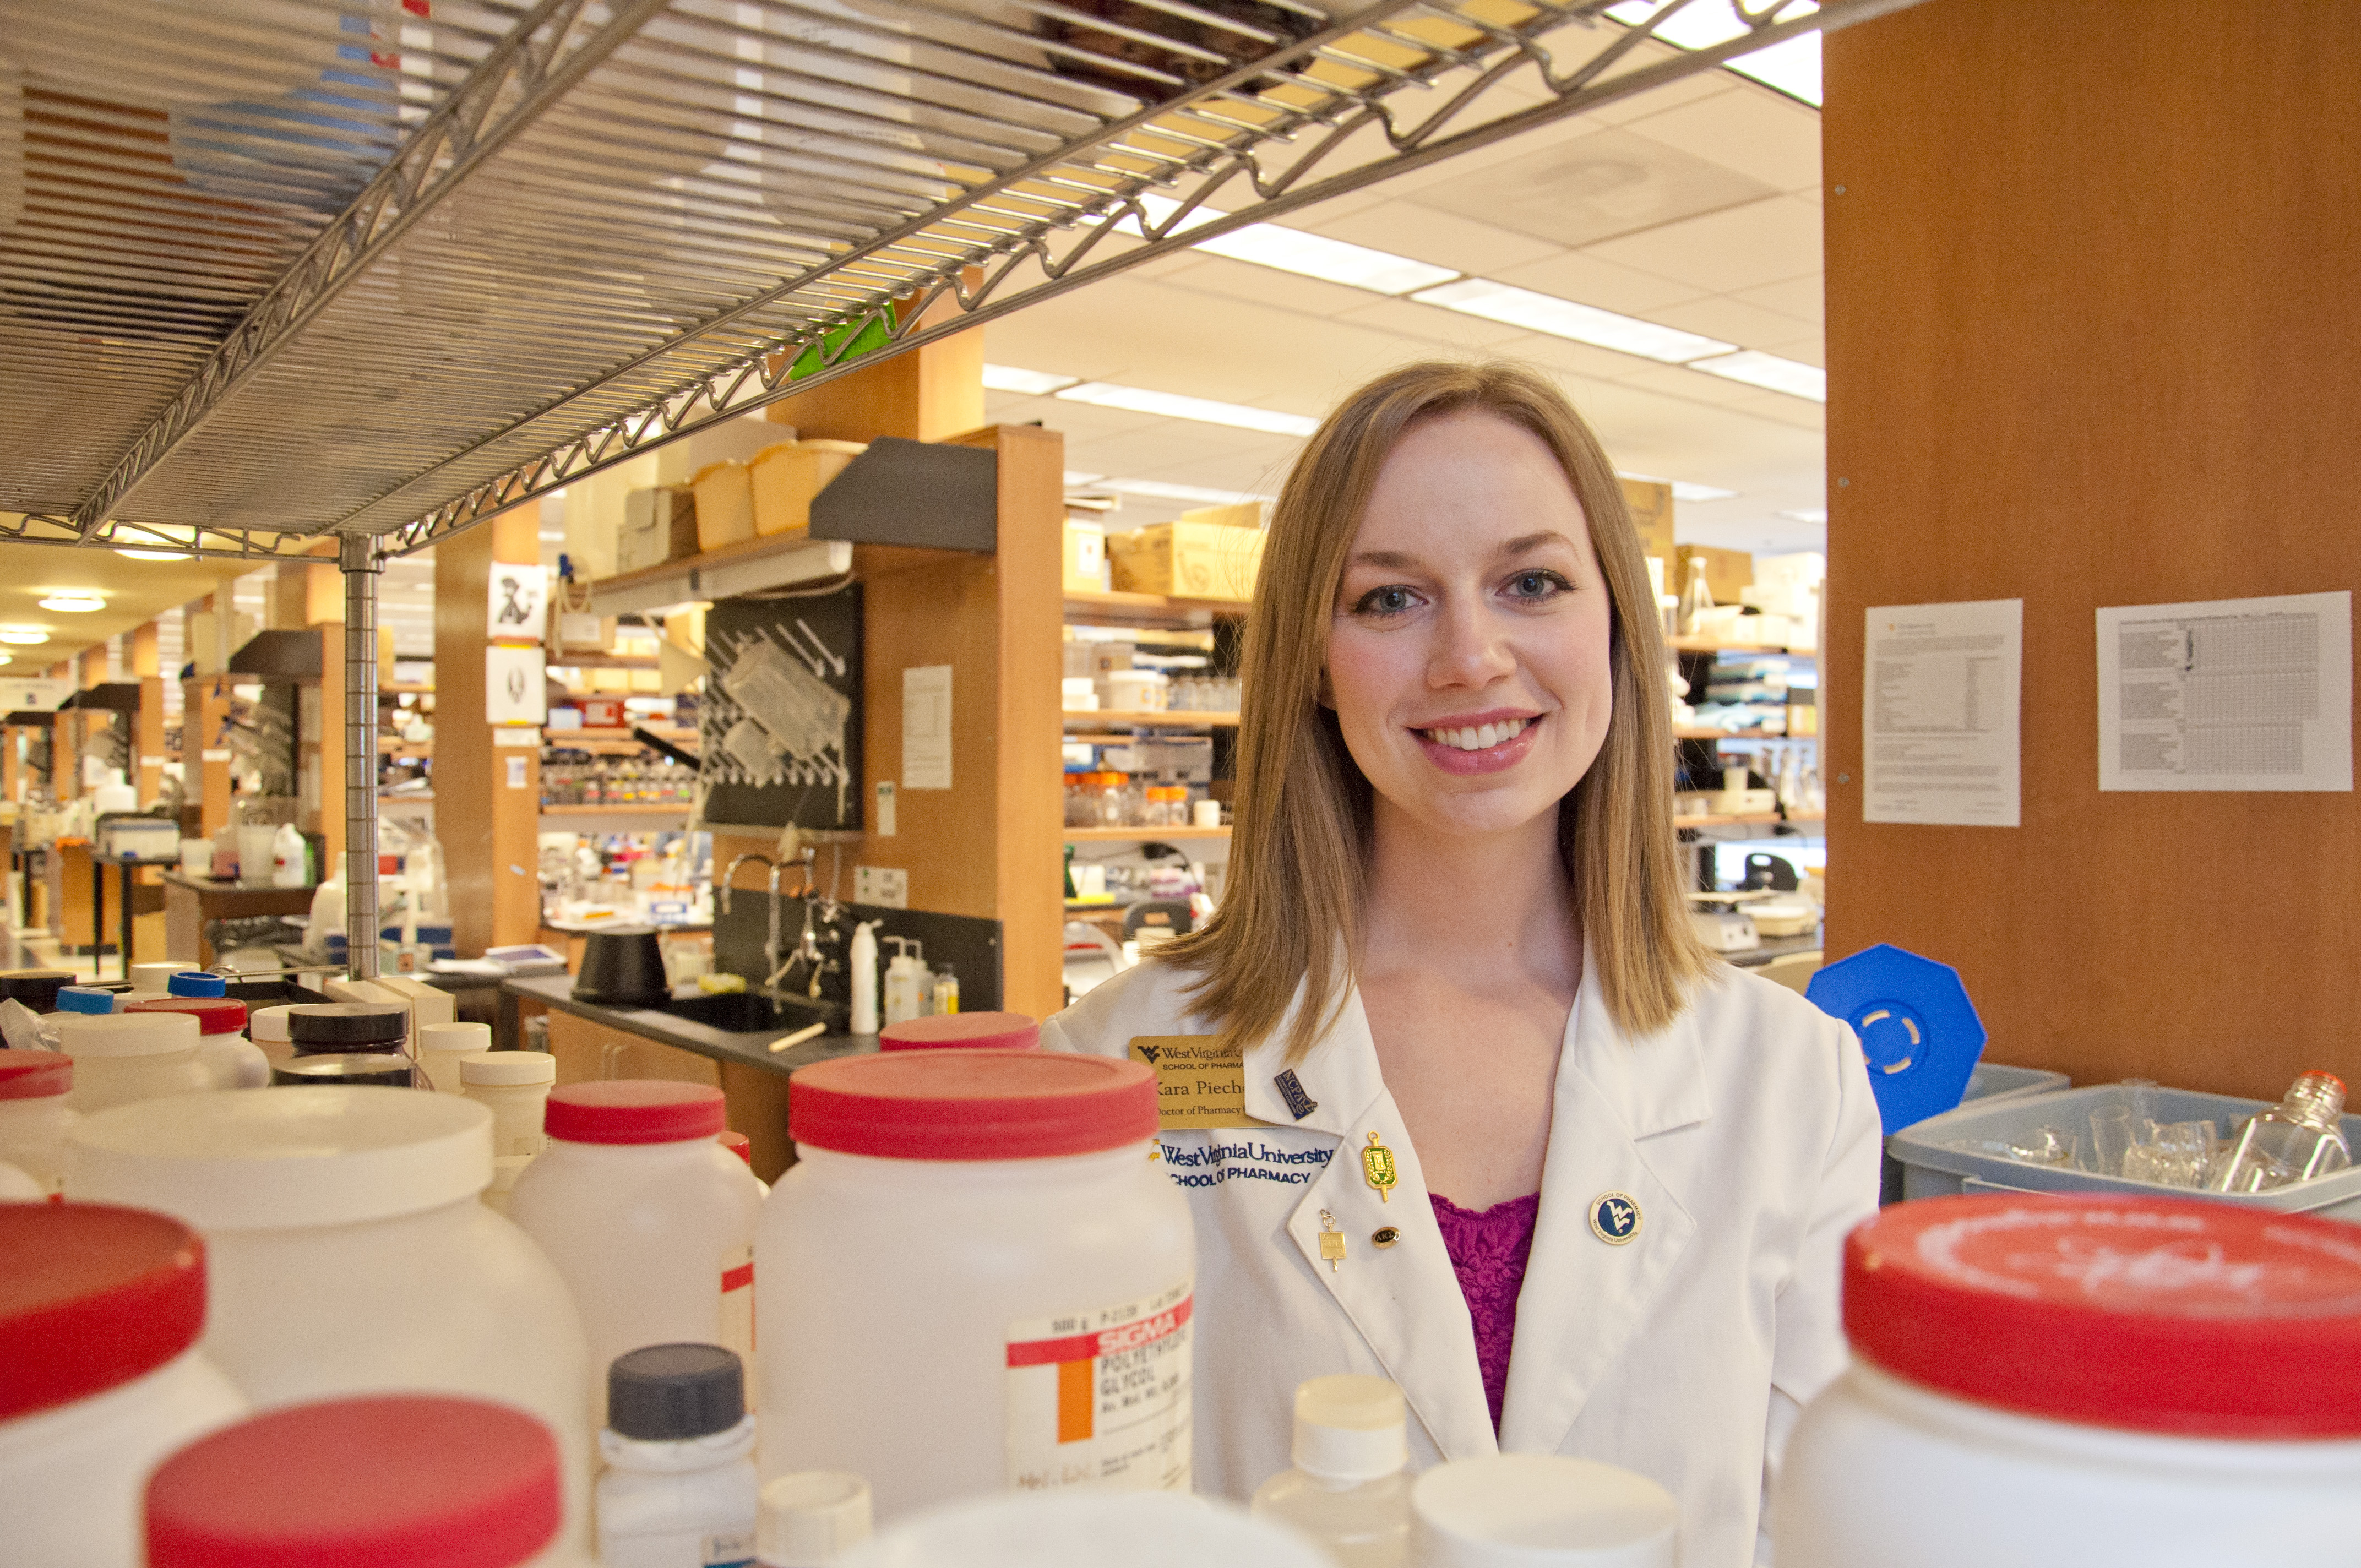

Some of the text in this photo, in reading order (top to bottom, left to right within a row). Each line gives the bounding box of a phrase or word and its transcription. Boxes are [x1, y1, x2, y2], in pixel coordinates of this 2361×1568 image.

[1187, 1106, 1195, 1114] of
[1198, 1105, 1241, 1117] Pharmacy
[1227, 1167, 1311, 1184] PHARMACY
[1596, 1193, 1615, 1206] SCHOOL
[1624, 1195, 1641, 1221] PHARMACY
[1598, 1228, 1614, 1242] Virginia
[1614, 1231, 1638, 1243] University
[1099, 1311, 1175, 1356] SIGMA
